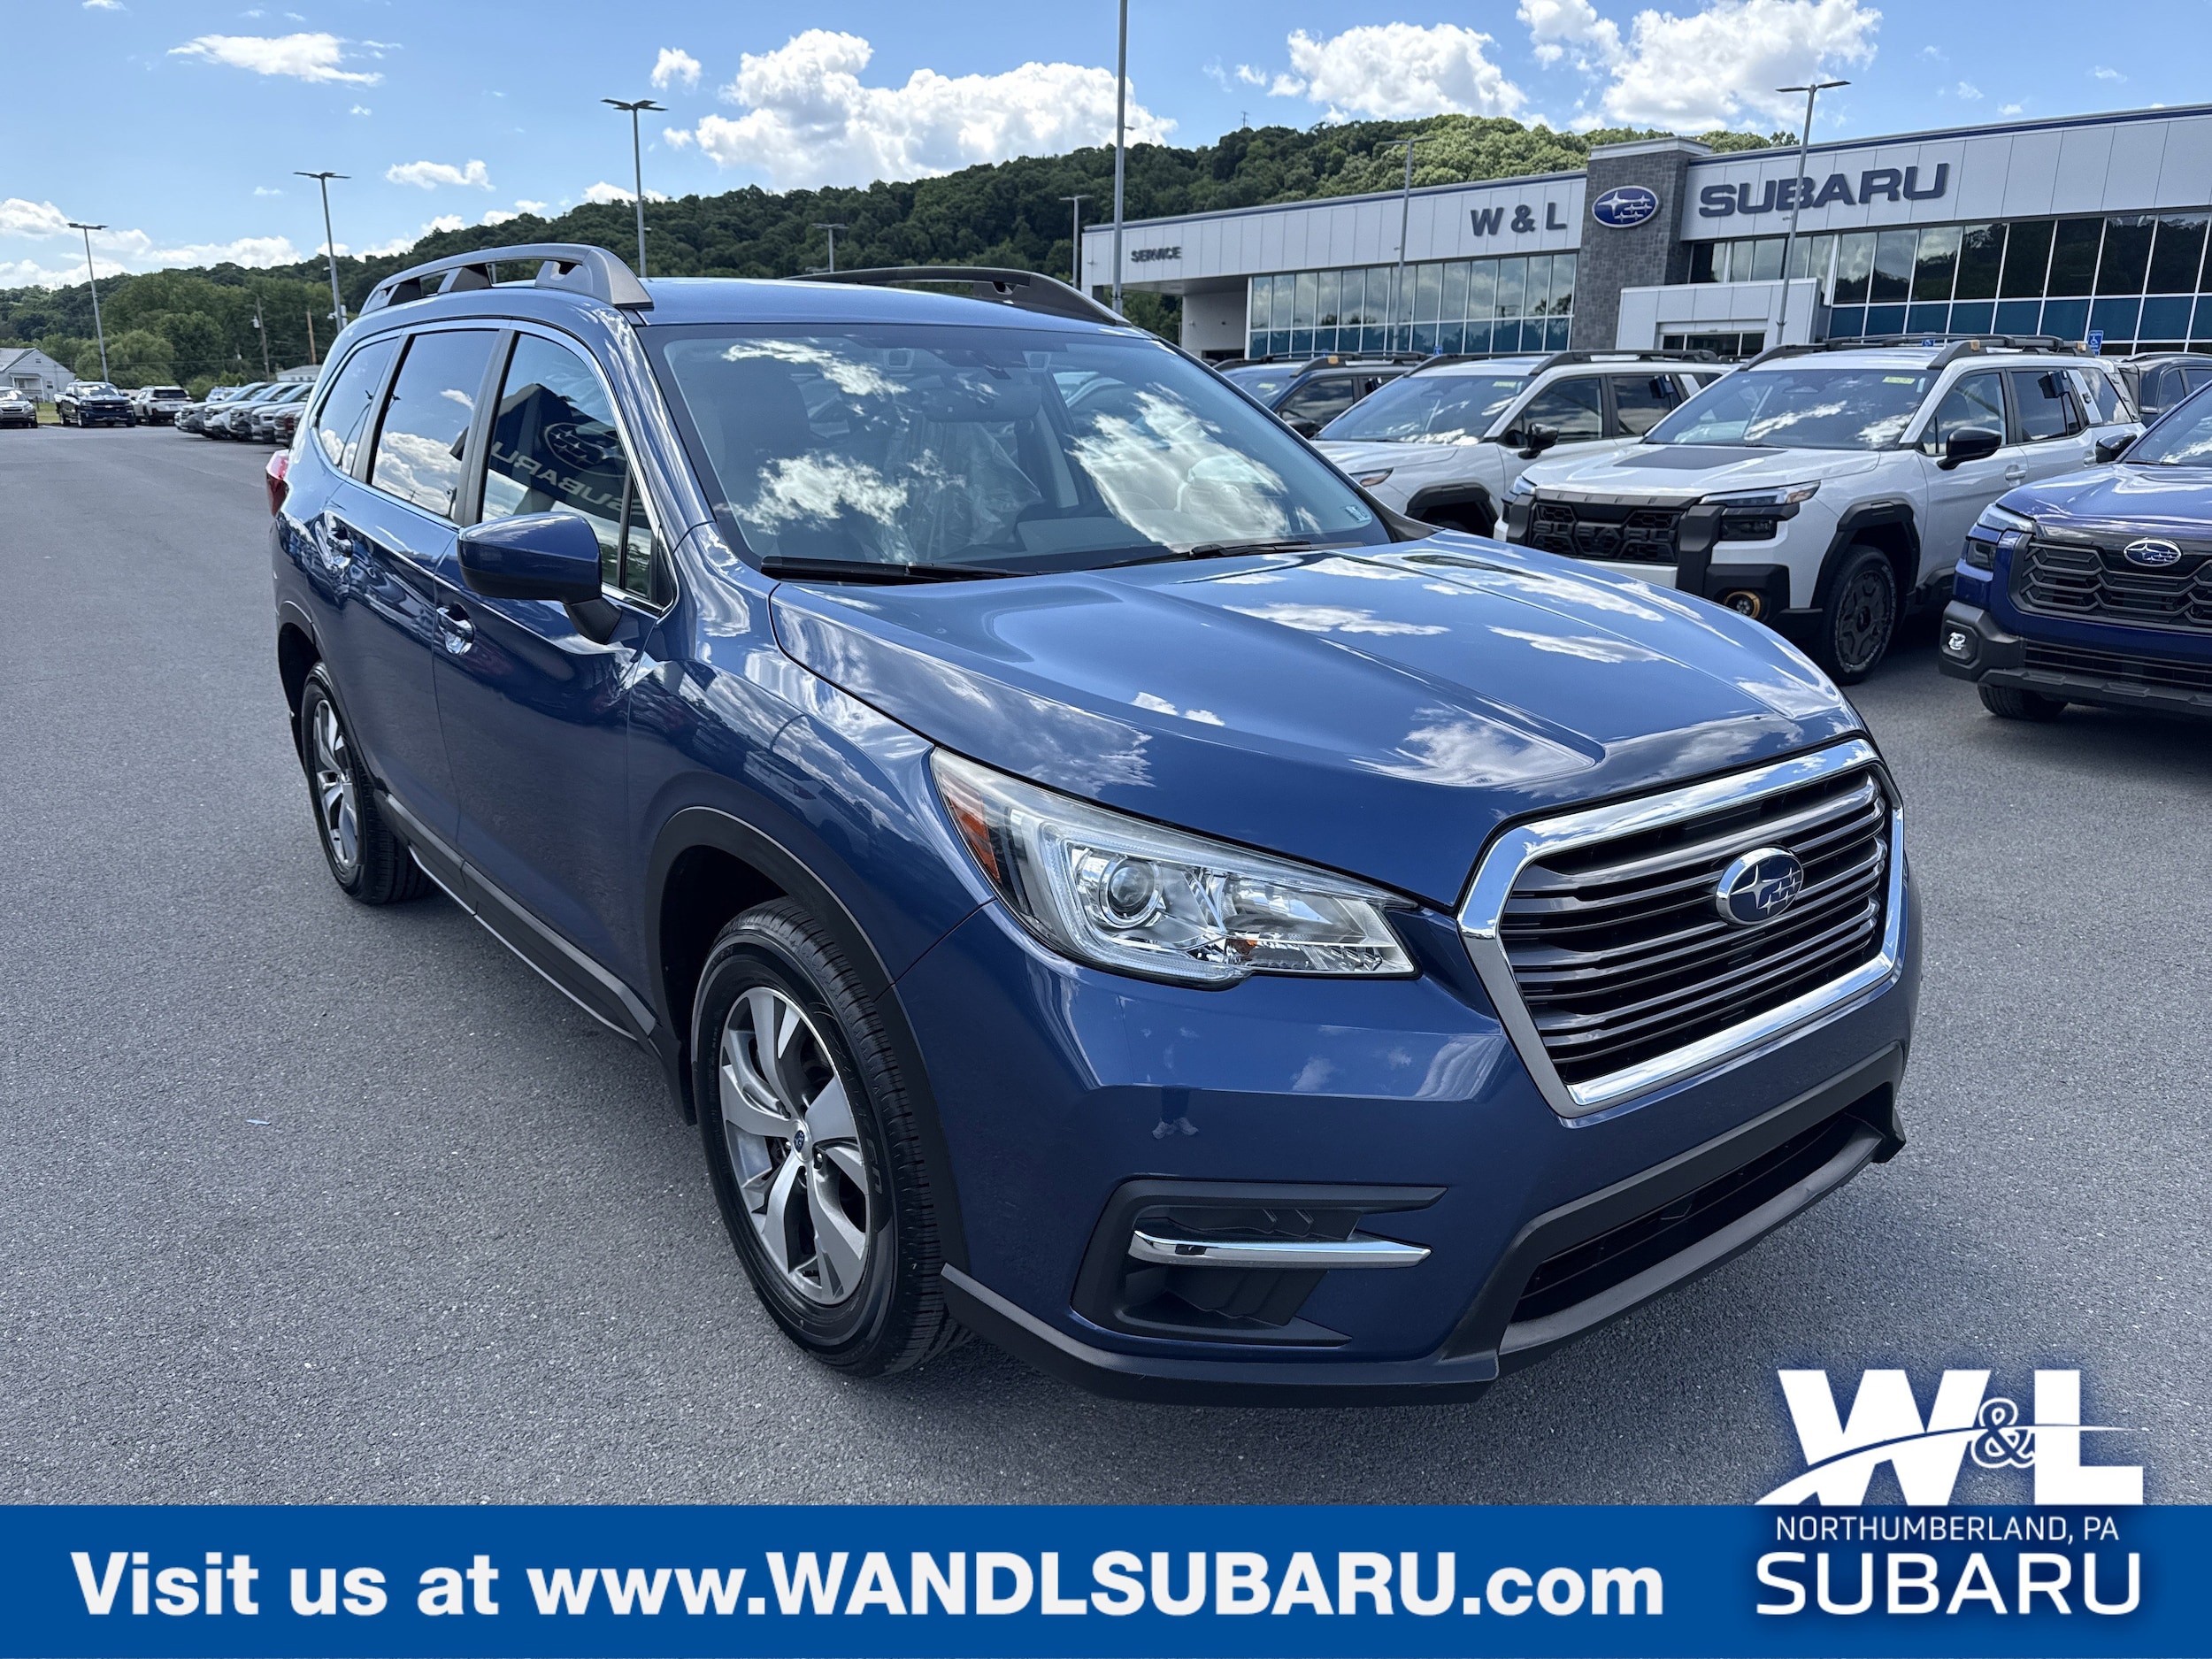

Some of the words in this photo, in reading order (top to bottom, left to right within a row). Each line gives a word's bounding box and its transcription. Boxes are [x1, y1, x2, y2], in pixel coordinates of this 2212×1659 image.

[1698, 162, 1950, 218] SUBARU
[1470, 207, 1504, 237] W
[1510, 204, 1536, 234] &
[1546, 202, 1568, 230] L
[1131, 246, 1182, 263] SERVICE
